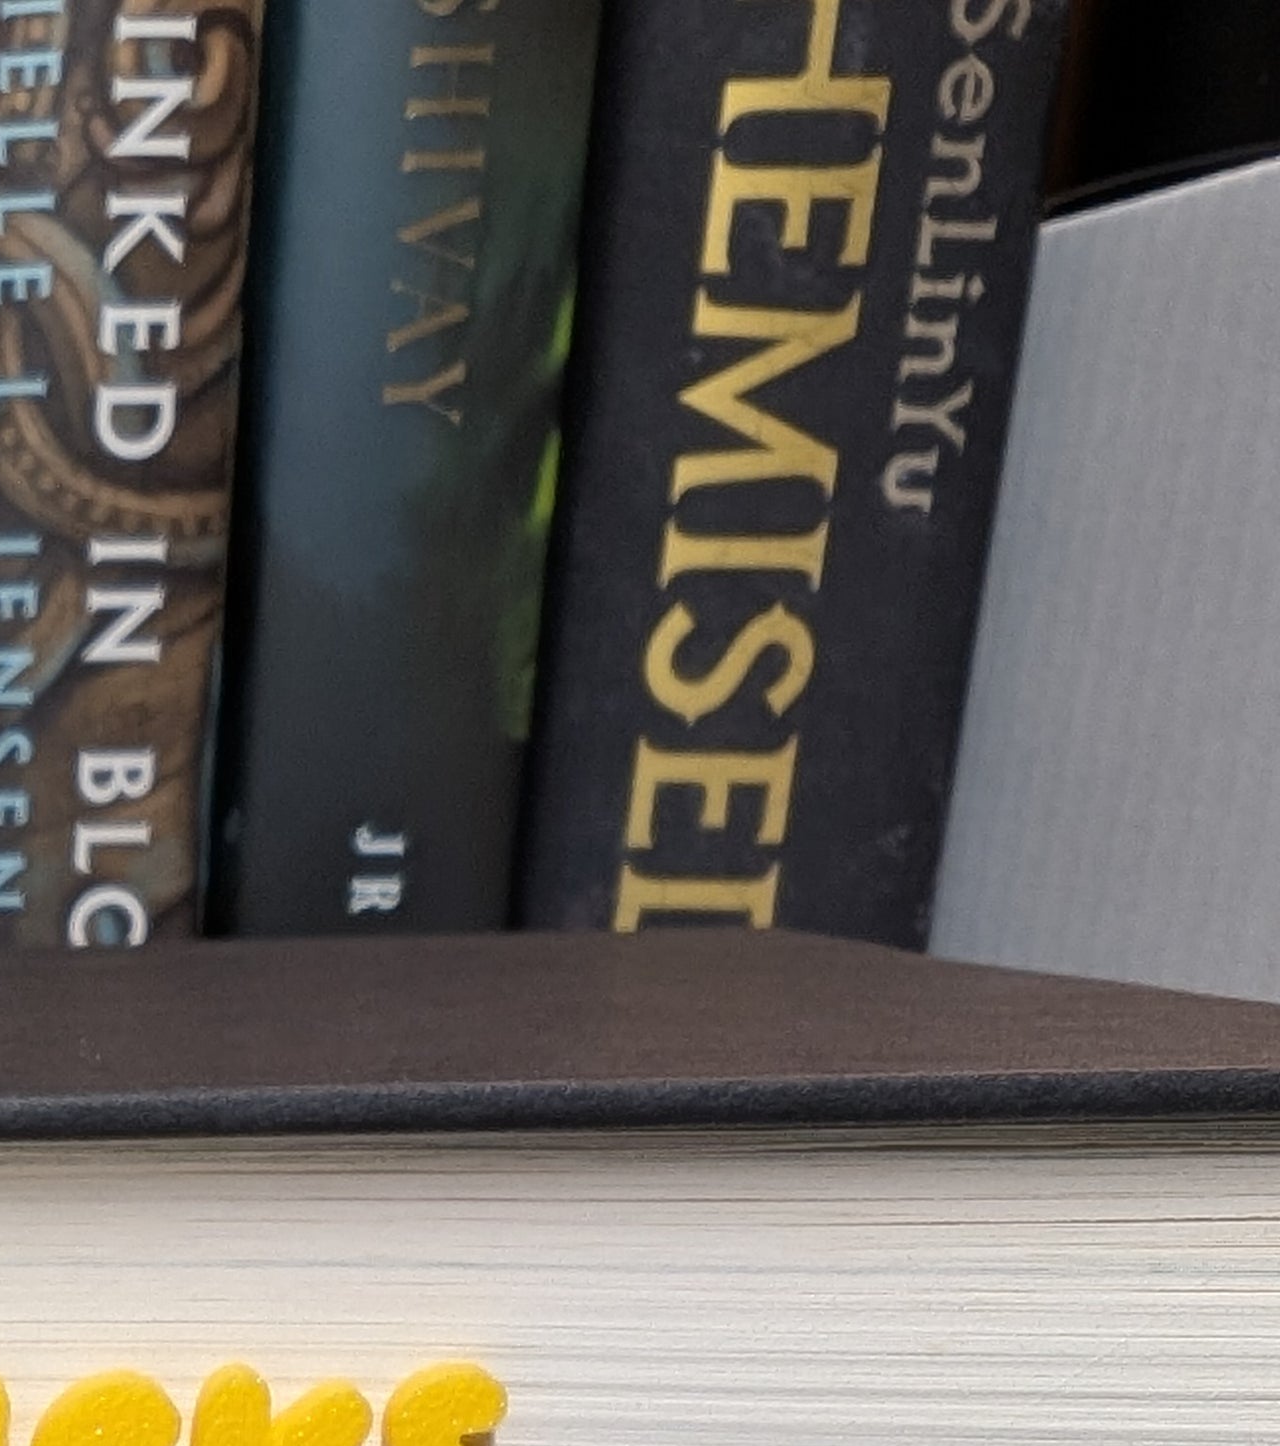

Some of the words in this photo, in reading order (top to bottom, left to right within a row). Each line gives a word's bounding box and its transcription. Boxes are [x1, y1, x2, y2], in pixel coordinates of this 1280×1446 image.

[92, 13, 198, 462] INKED
[382, 0, 498, 427] HIVAY
[84, 534, 167, 665] IN
